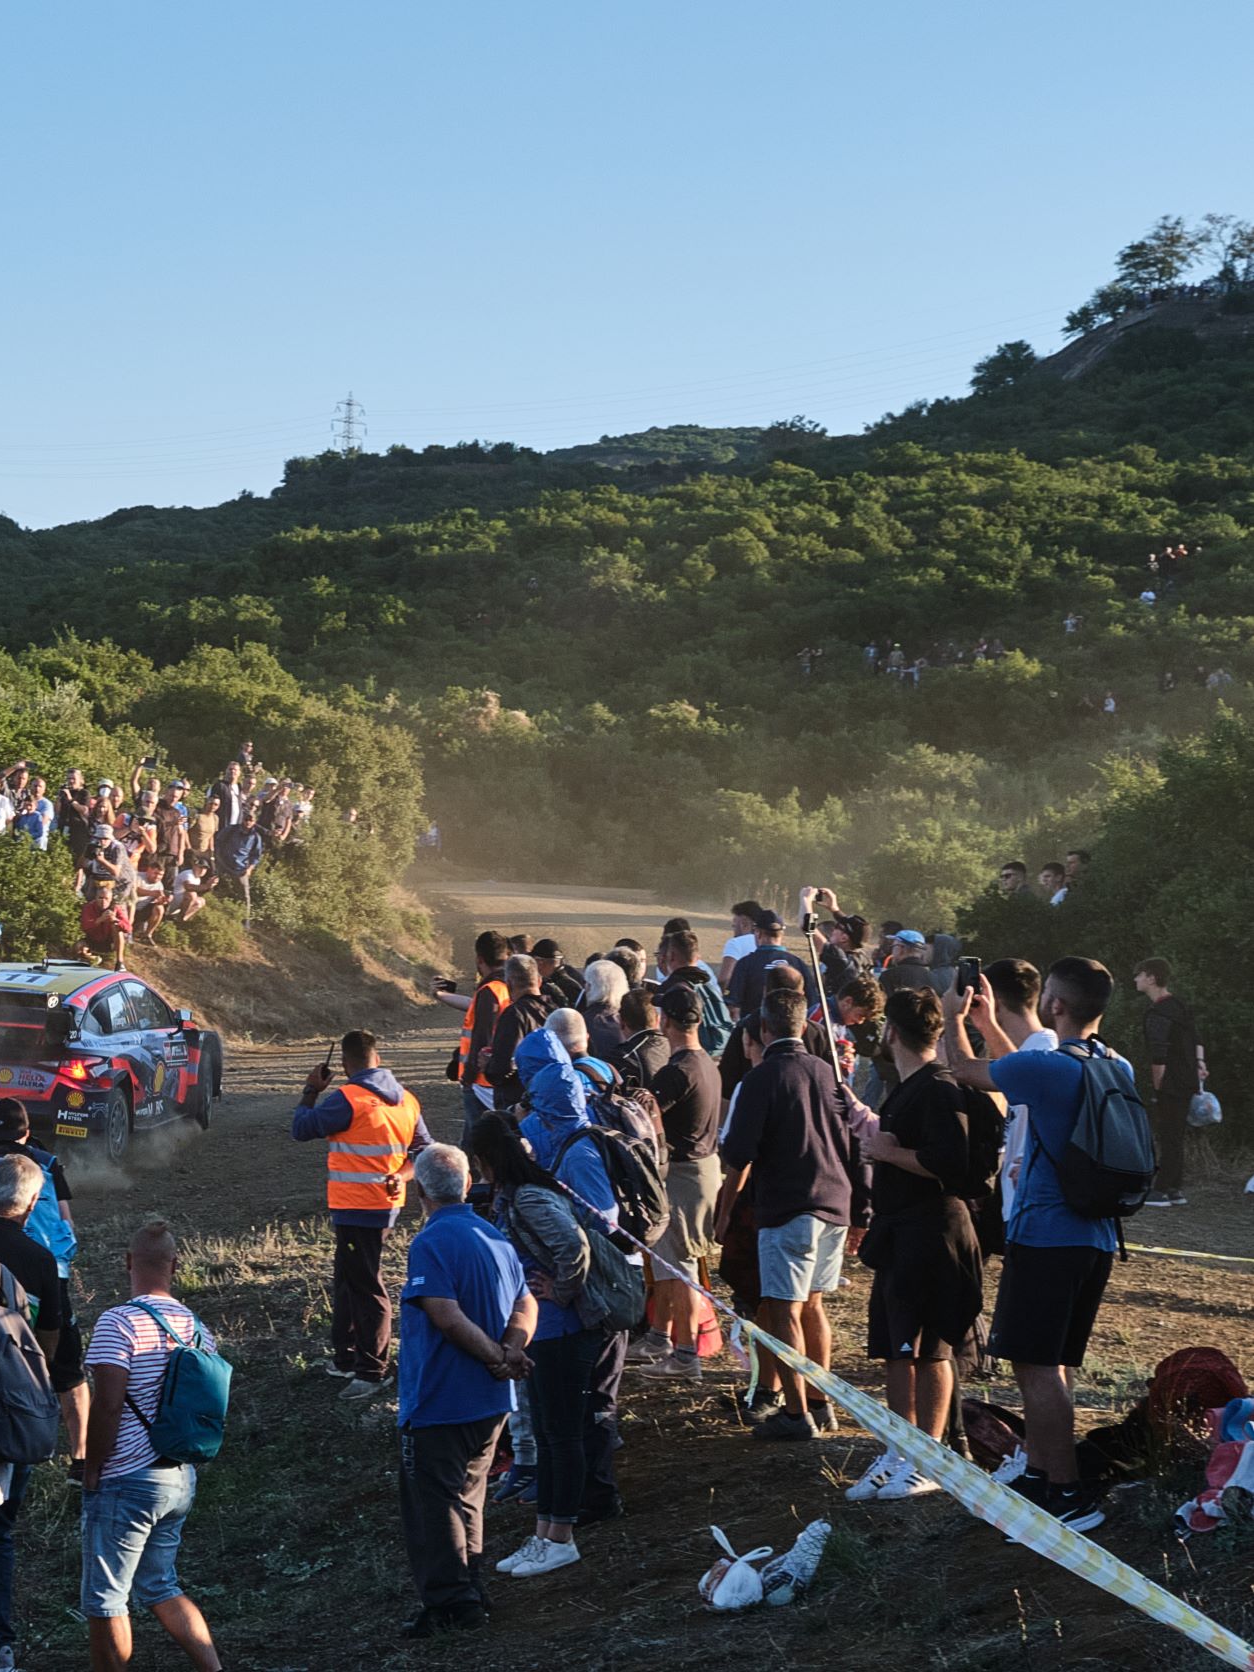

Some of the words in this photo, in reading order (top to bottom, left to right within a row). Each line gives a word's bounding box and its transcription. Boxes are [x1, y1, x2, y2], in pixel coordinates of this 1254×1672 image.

[4, 973, 43, 983] 11
[18, 1079, 44, 1088] ULTRA
[58, 1126, 86, 1136] PIRELLI
